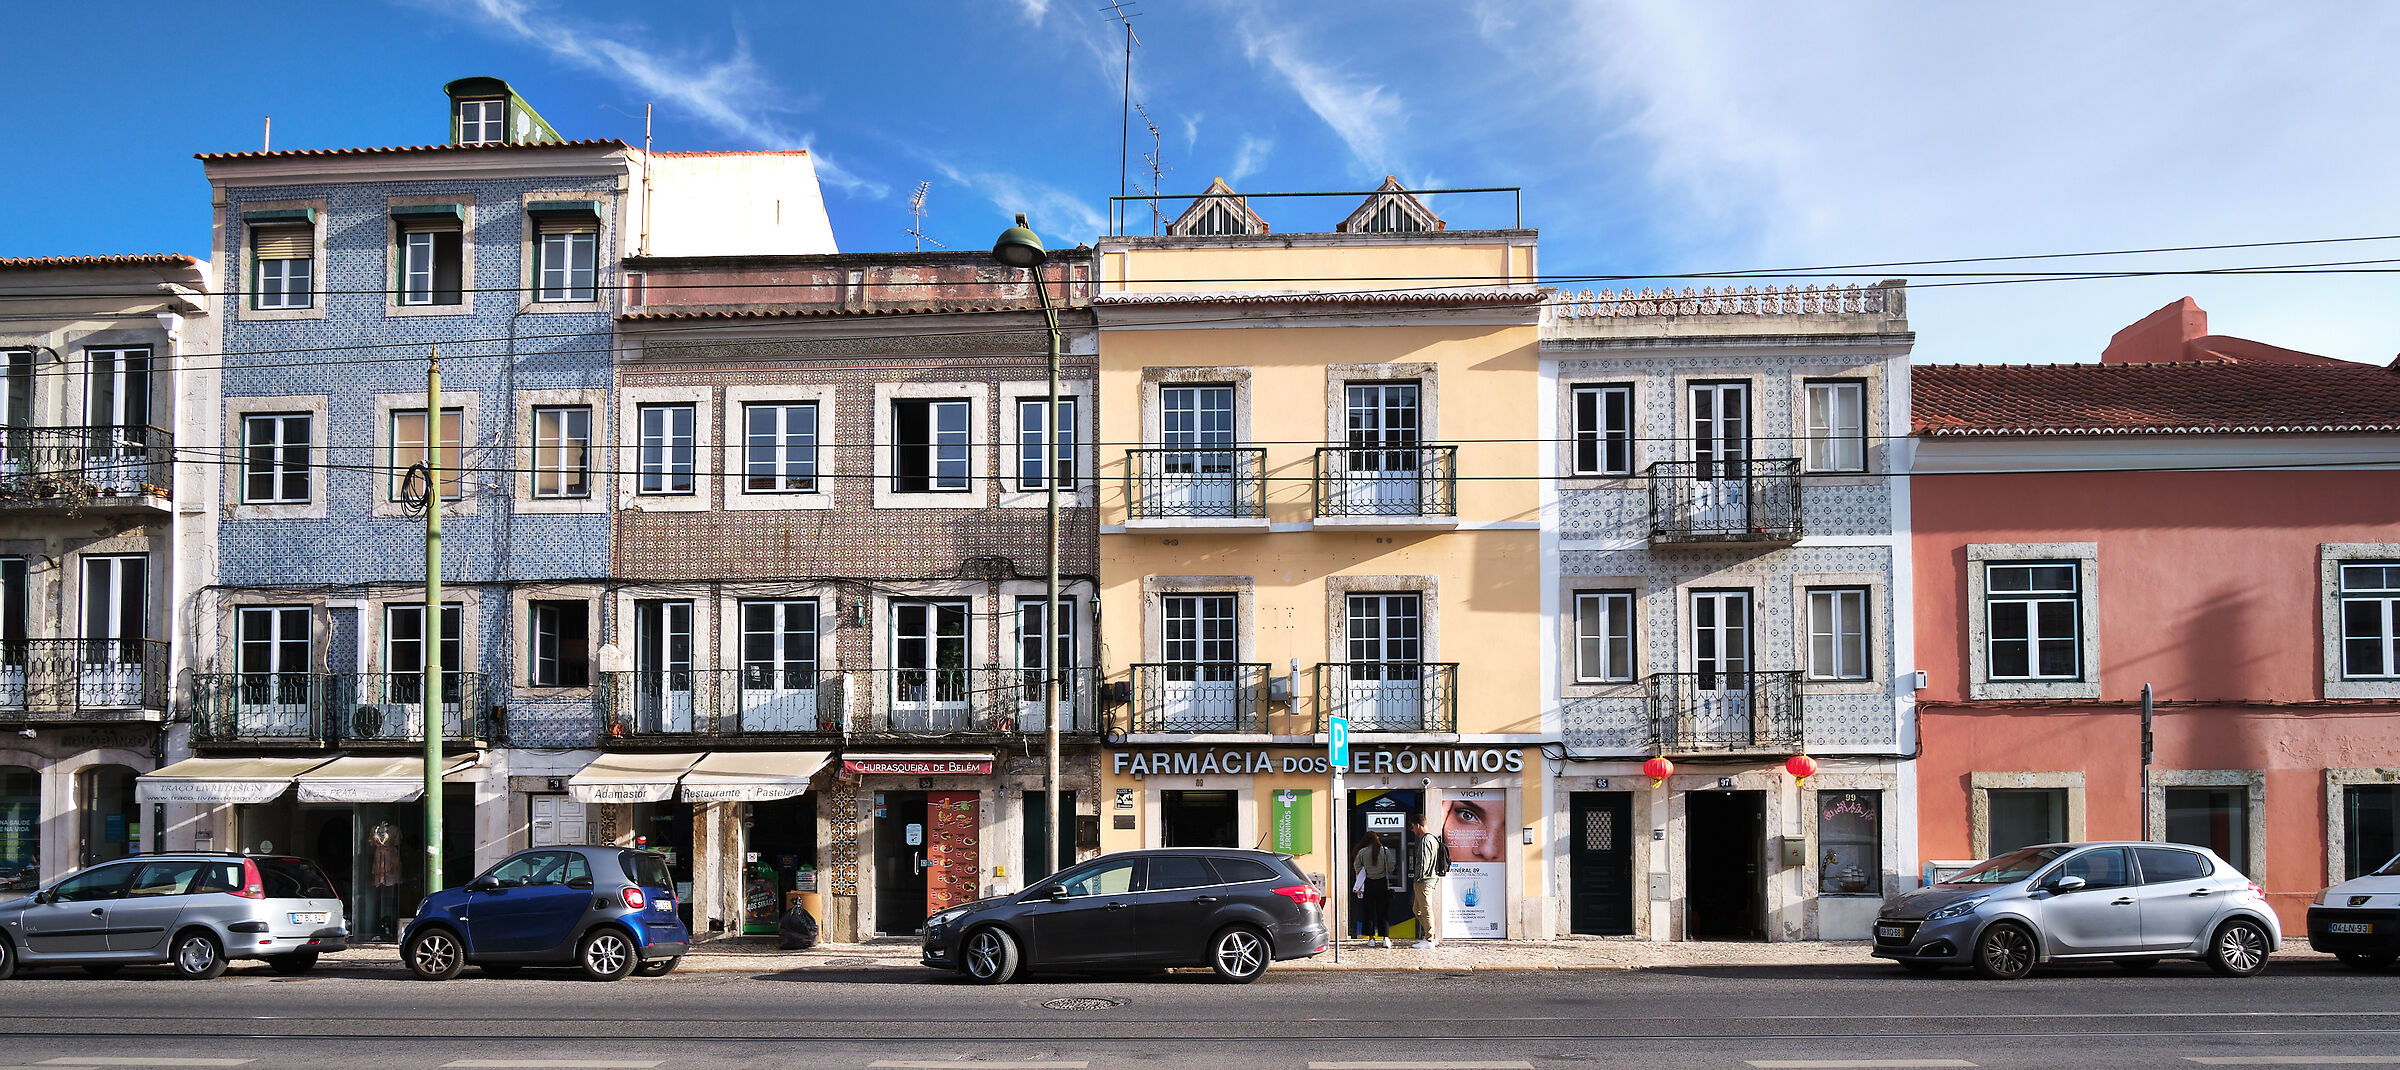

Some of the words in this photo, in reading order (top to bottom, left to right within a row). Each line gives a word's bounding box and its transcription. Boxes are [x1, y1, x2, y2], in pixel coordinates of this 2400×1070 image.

[1334, 723, 1344, 760] P
[1114, 747, 1274, 774] FARMÁCIA
[1282, 757, 1328, 773] DOS
[1342, 745, 1525, 774] ERÓNIMOS
[855, 761, 930, 773] CHURRASQUEIRA
[948, 761, 980, 772] BELÉM
[160, 783, 194, 792] TRAÇO
[195, 783, 222, 792] LIVRE
[224, 783, 262, 792] DESIGN
[1597, 779, 1606, 787] 95
[1720, 778, 1729, 787] 97
[594, 789, 647, 799] Adamastor
[684, 788, 740, 799] Restaurante
[1845, 793, 1856, 801] 99
[1374, 817, 1399, 825] ATM
[2332, 923, 2368, 933] 04-LN-93
